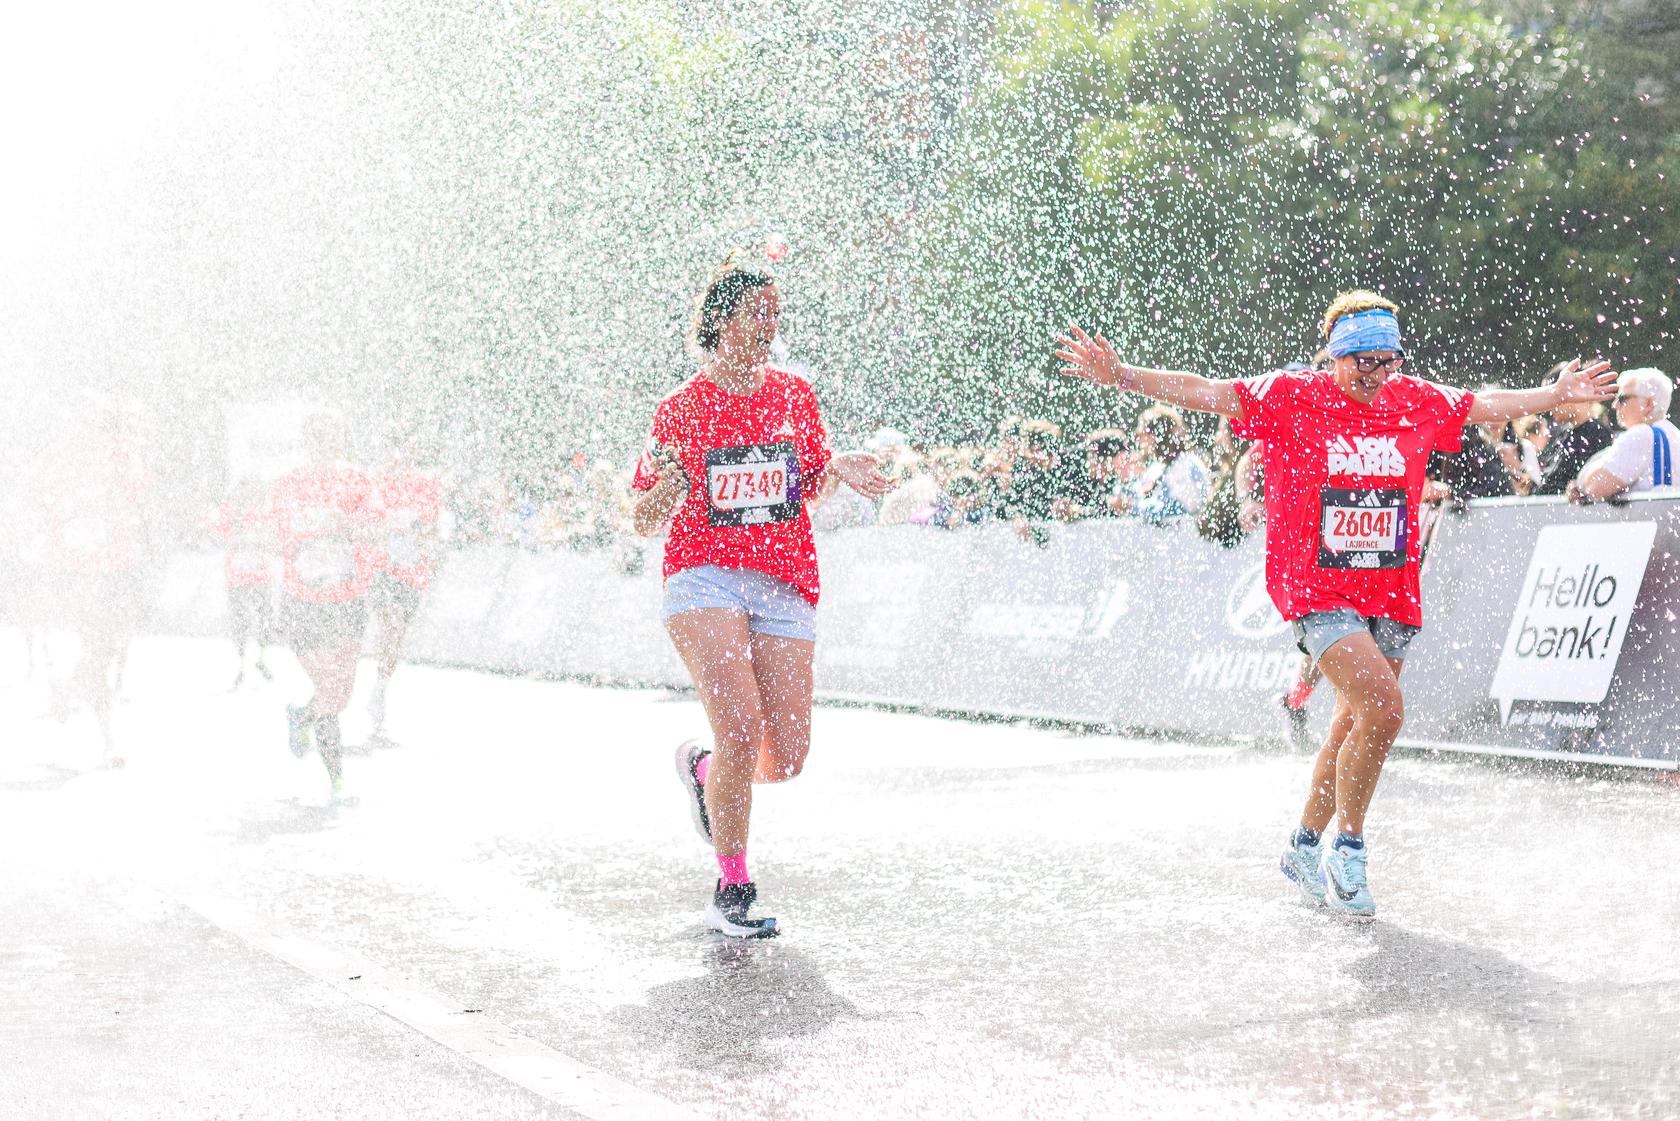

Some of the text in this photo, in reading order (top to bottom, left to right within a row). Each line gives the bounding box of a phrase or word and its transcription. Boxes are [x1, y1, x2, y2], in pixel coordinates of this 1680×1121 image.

[1328, 453, 1406, 477] PARIS
[715, 470, 784, 501] 27349
[1333, 510, 1392, 537] 26041
[1345, 540, 1379, 549] LAURENCE
[1528, 563, 1617, 608] Hello
[1515, 615, 1617, 660] bank!
[1183, 651, 1304, 690] HYUNDA
